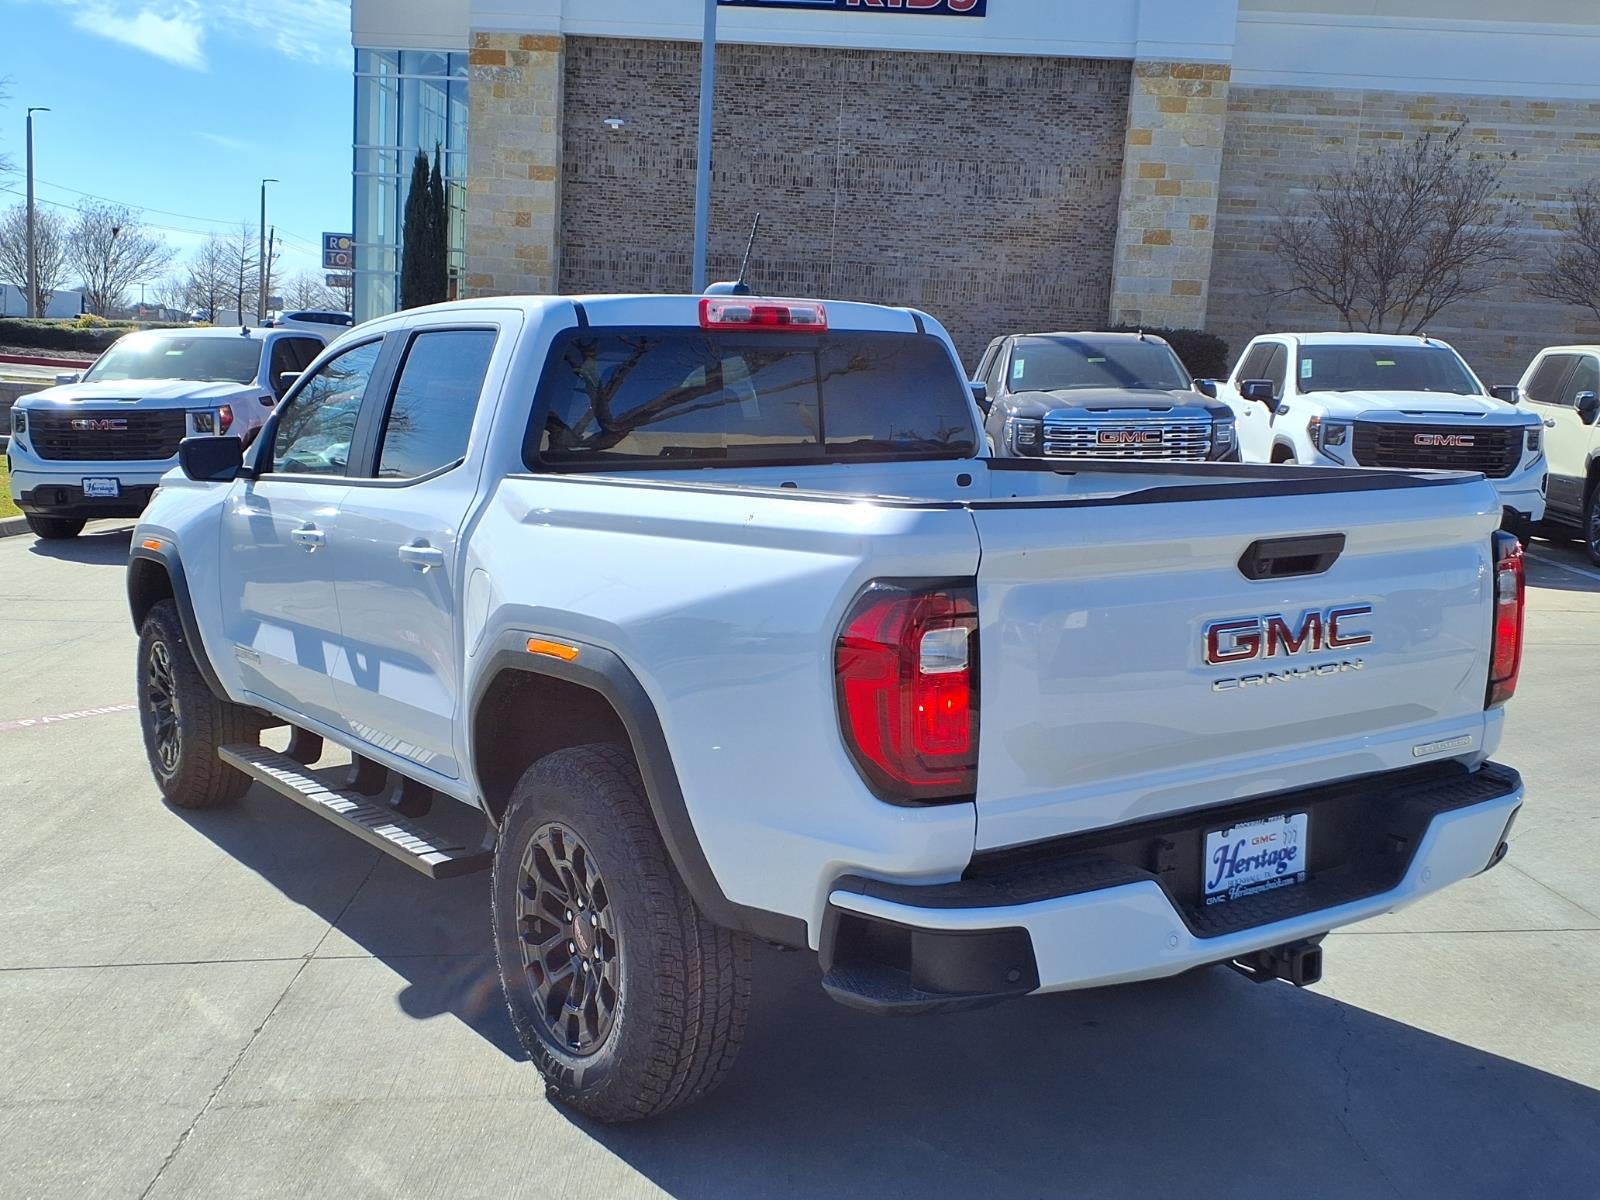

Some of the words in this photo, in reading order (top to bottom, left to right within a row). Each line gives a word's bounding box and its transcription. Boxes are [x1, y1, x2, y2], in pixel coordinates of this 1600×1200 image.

[72, 419, 127, 430] GMC
[1100, 431, 1160, 442] GMC
[1414, 433, 1474, 446] GMC
[1203, 602, 1373, 665] GMC
[1212, 658, 1365, 692] CANYON
[1251, 833, 1277, 845] GMC
[1207, 839, 1298, 890] Heritage
